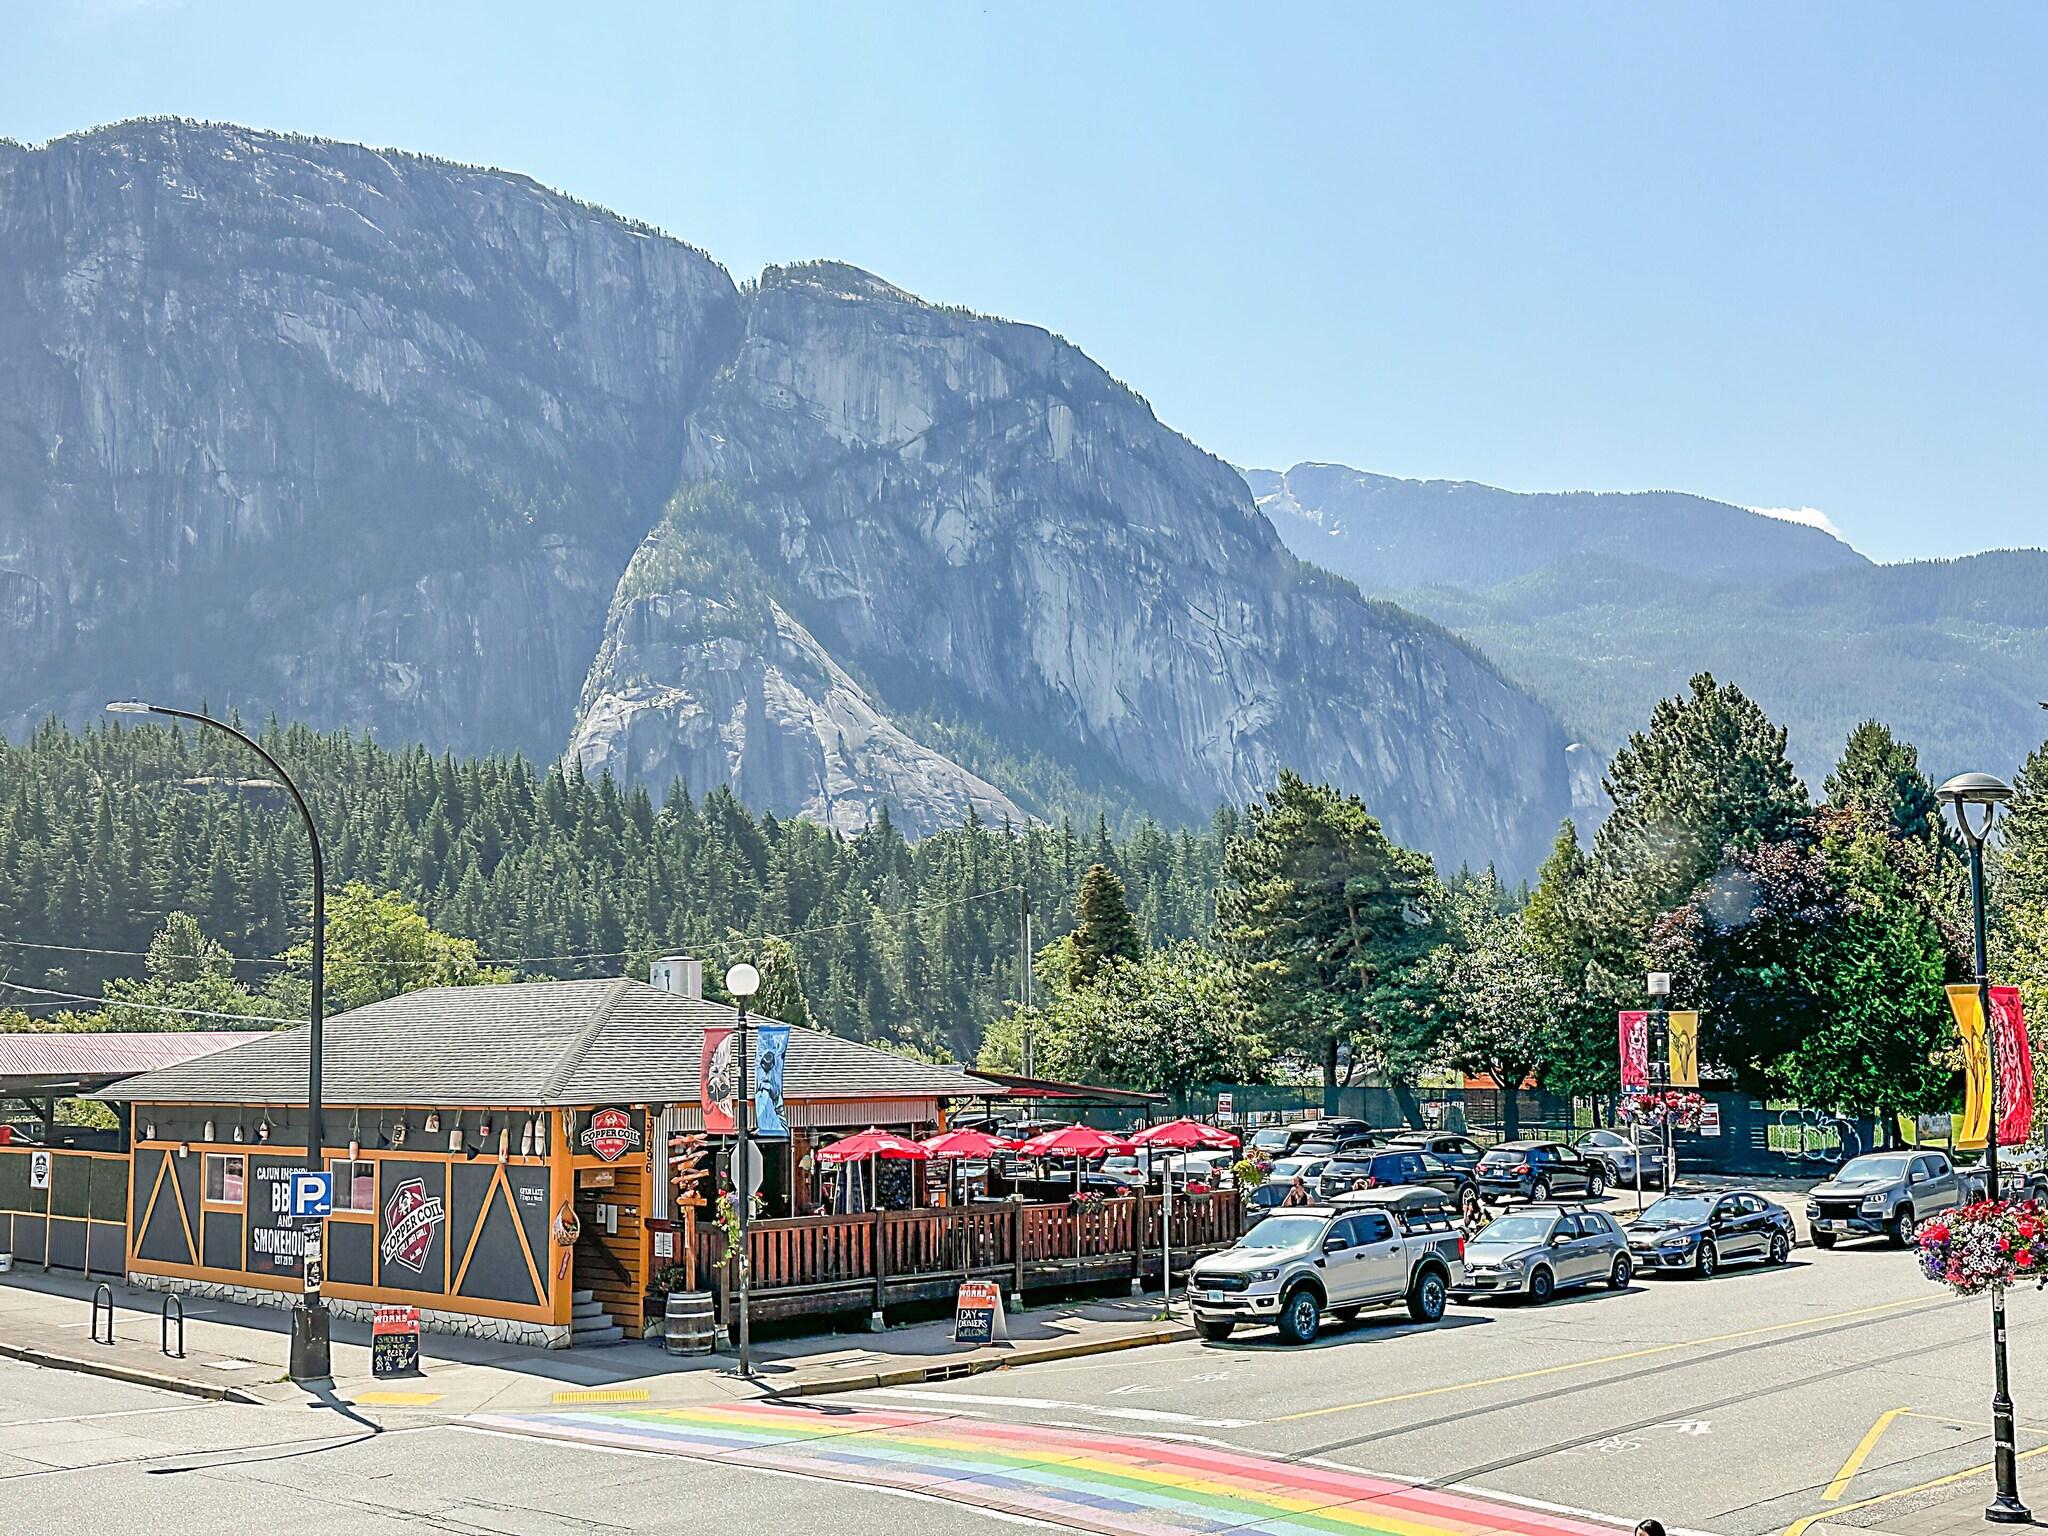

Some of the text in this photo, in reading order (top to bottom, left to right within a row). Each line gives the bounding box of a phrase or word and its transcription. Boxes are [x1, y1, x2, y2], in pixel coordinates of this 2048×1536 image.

[583, 1129, 640, 1143] COPPER COIL
[256, 1167, 280, 1181] CAJUN
[271, 1182, 290, 1213] BB
[296, 1177, 326, 1214] P
[277, 1214, 293, 1228] AND
[384, 1215, 418, 1259] COPPER
[417, 1202, 443, 1222] COIL
[254, 1227, 304, 1257] SMOKEHOU
[373, 1314, 408, 1324] WORKS
[961, 1310, 977, 1320] DAY
